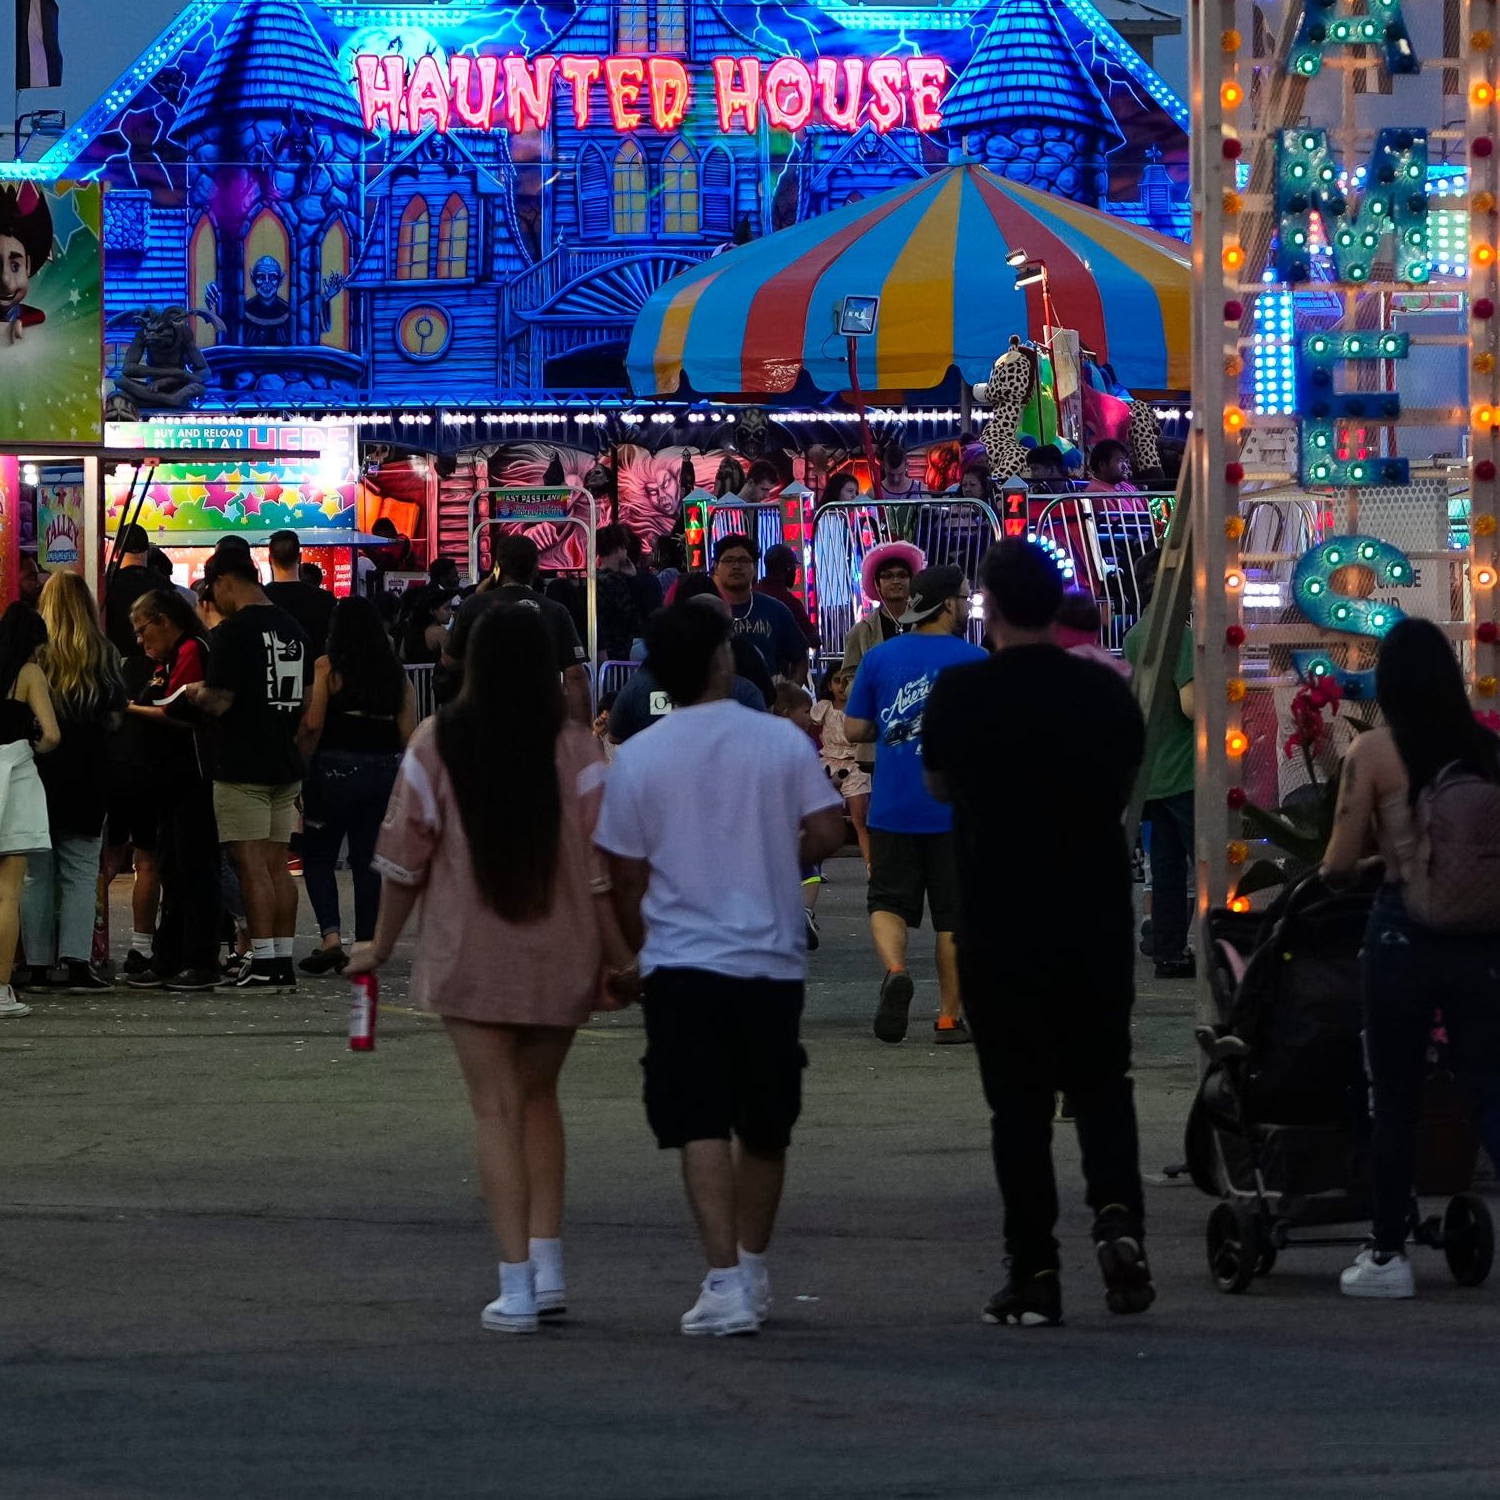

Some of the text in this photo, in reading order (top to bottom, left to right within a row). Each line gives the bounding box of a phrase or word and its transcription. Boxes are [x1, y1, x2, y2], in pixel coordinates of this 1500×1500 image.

[354, 53, 948, 134] HAUNTED HOUSE
[154, 429, 173, 437] BUY
[177, 429, 200, 437] AND
[204, 429, 243, 437] RELOAD
[248, 427, 350, 467] HERE
